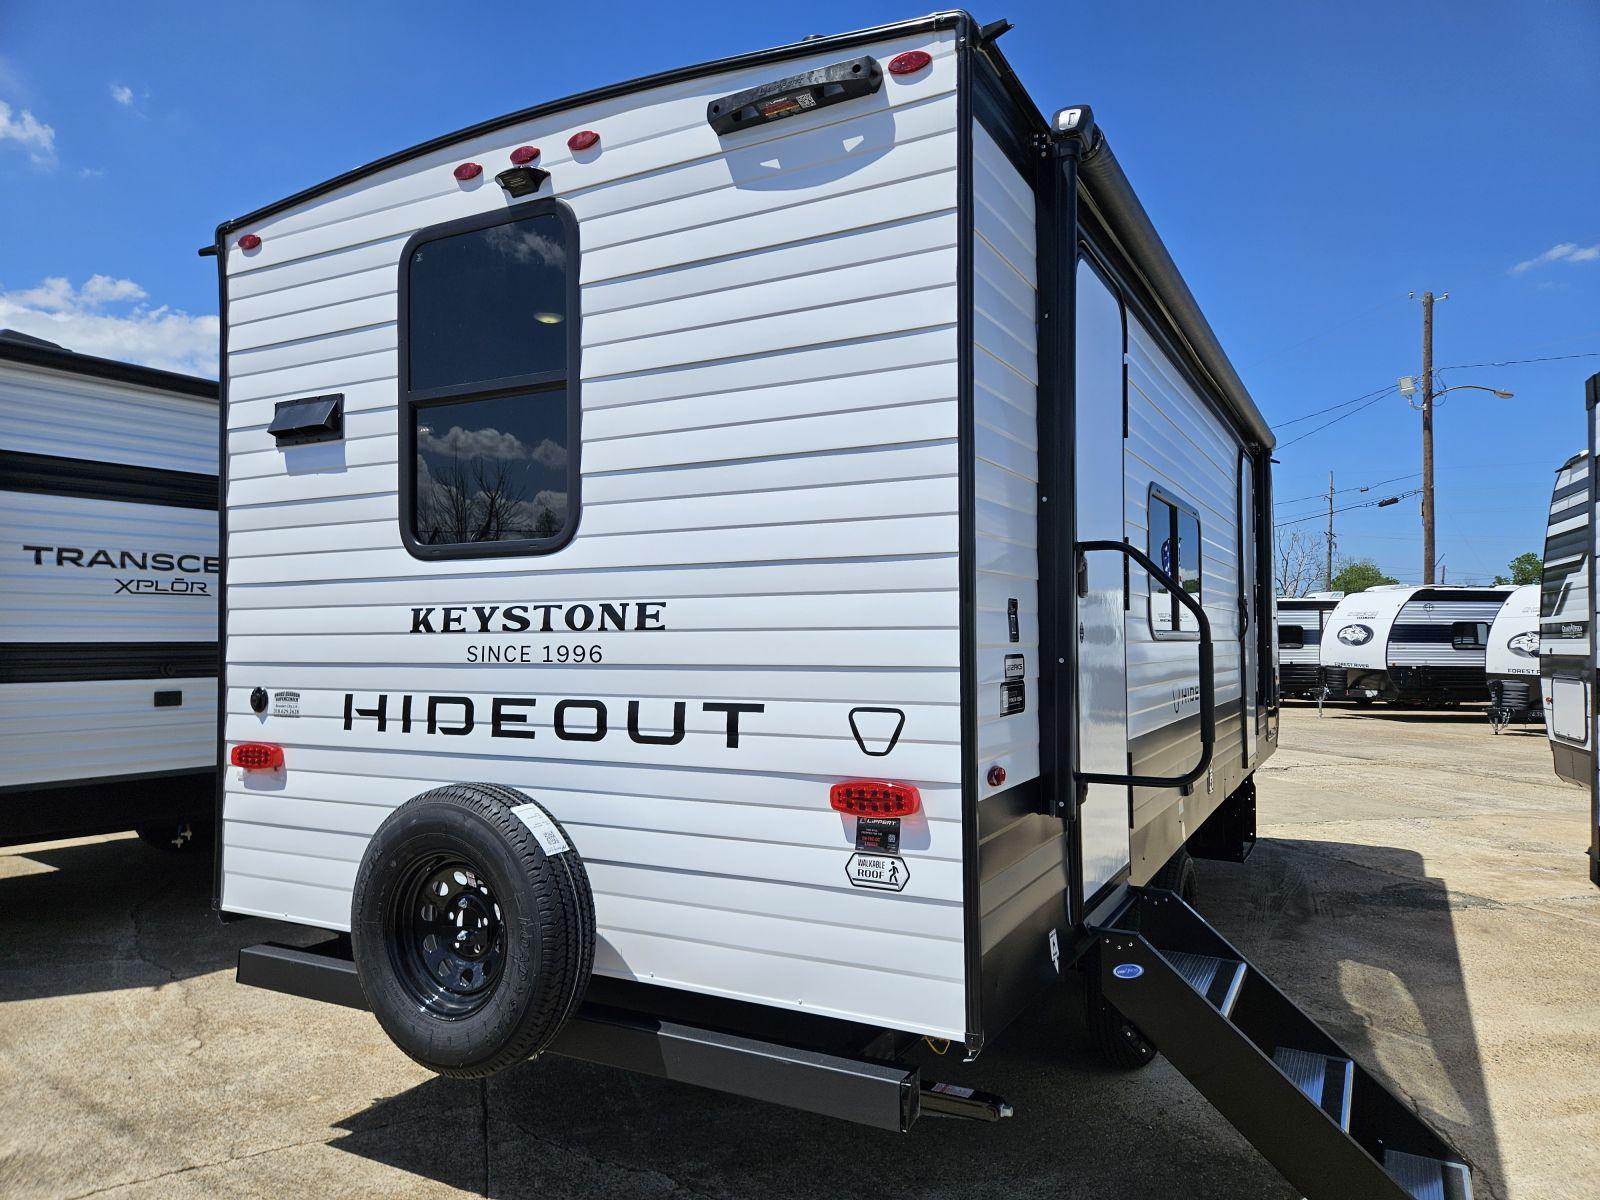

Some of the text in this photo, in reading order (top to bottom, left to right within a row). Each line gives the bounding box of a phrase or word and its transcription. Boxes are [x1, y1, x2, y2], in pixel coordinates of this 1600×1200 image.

[410, 601, 667, 633] KEYSTONE
[466, 644, 603, 663] SINCE 1996
[343, 693, 765, 749] HIDEOUT
[858, 859, 886, 870] WALKABLE
[858, 869, 885, 879] ROOF
